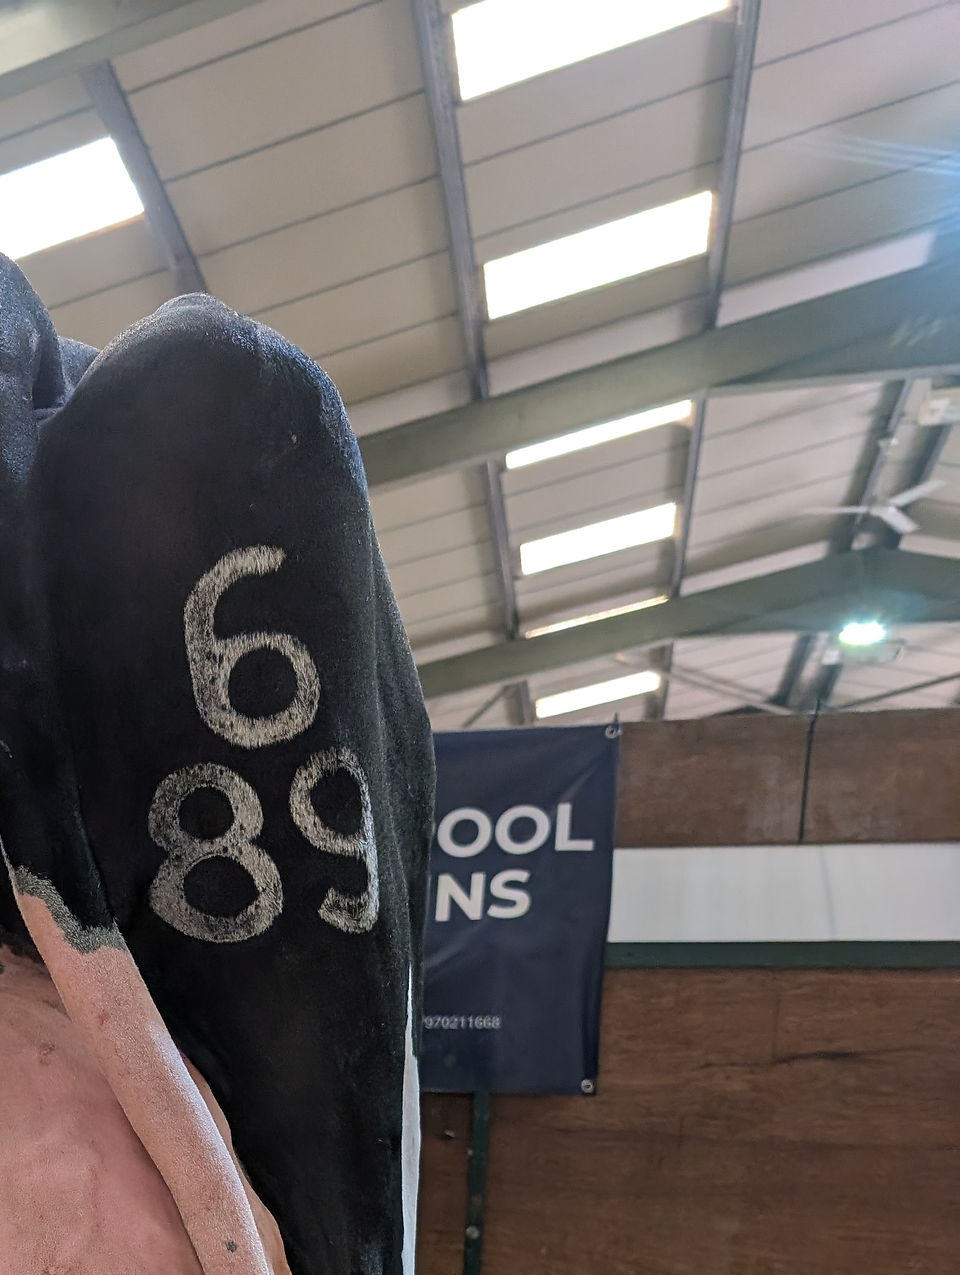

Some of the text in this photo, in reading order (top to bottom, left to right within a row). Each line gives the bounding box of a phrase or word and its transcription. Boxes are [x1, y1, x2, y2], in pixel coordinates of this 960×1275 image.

[184, 545, 320, 750] 6
[437, 802, 595, 858] OOL
[434, 869, 531, 922] NS
[422, 1015, 501, 1029] 970211668
